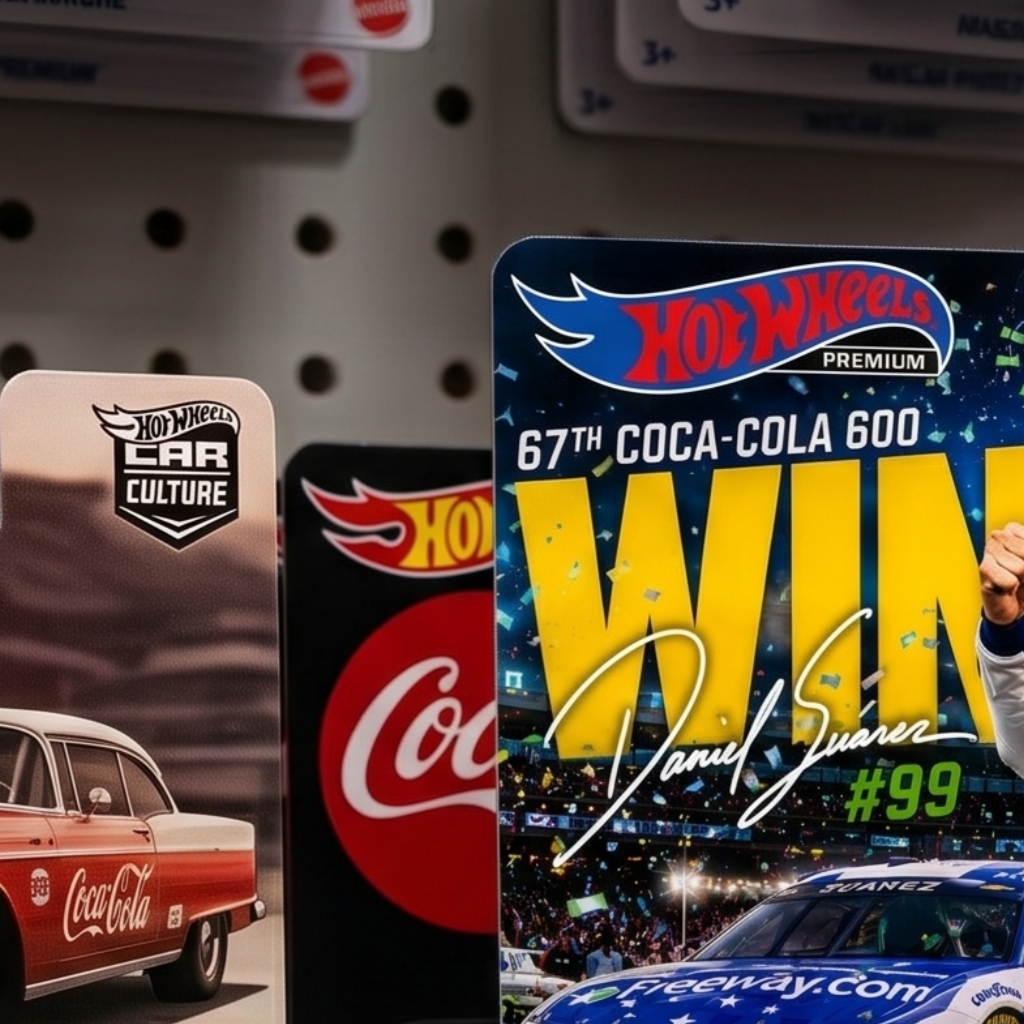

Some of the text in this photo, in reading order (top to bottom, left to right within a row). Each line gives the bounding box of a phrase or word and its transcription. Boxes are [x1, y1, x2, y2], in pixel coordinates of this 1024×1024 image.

[822, 351, 926, 372] PREMIUM
[516, 407, 921, 472] 67TH COCA-COLA 600
[124, 440, 229, 469] CAR
[126, 478, 228, 507] CULTURE
[844, 760, 962, 823] #99
